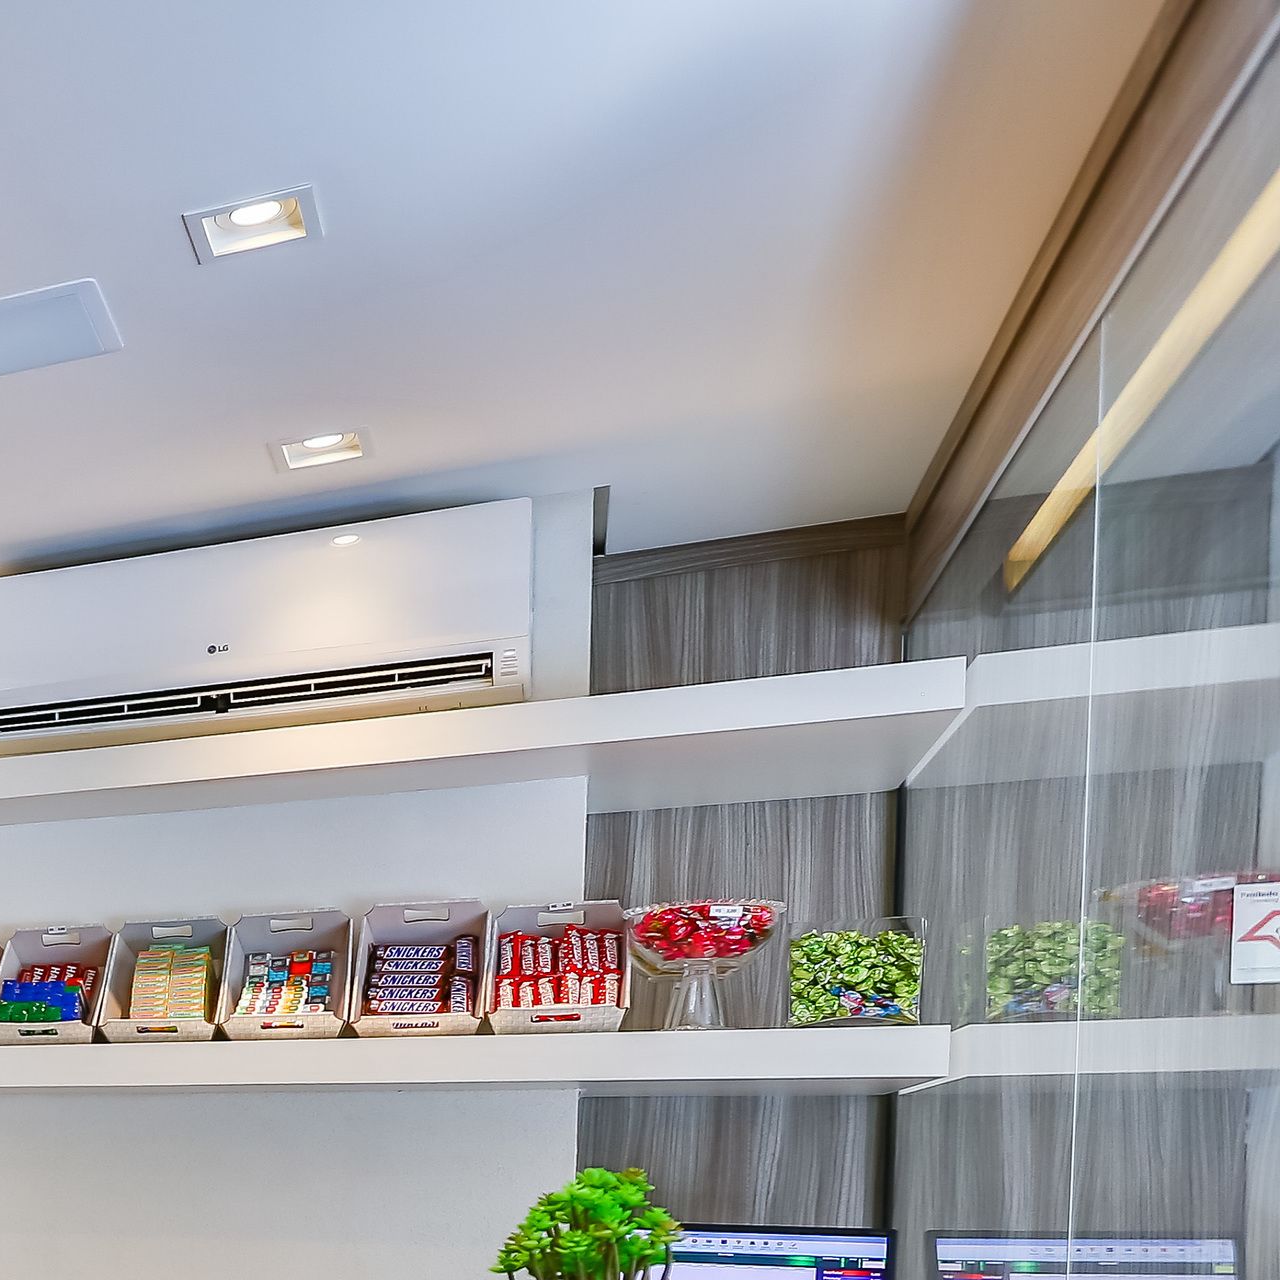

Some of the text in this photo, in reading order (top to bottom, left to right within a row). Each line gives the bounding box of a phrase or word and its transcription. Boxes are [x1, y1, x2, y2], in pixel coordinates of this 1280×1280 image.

[217, 644, 229, 653] LG
[385, 946, 444, 958] SNICKERS
[384, 961, 442, 970] SNICKERS
[32, 966, 45, 983] HAL
[48, 966, 61, 982] HAL
[381, 975, 440, 986] SNICKERS
[379, 988, 437, 999] SNICKERS
[380, 1001, 439, 1012] SNICKERS
